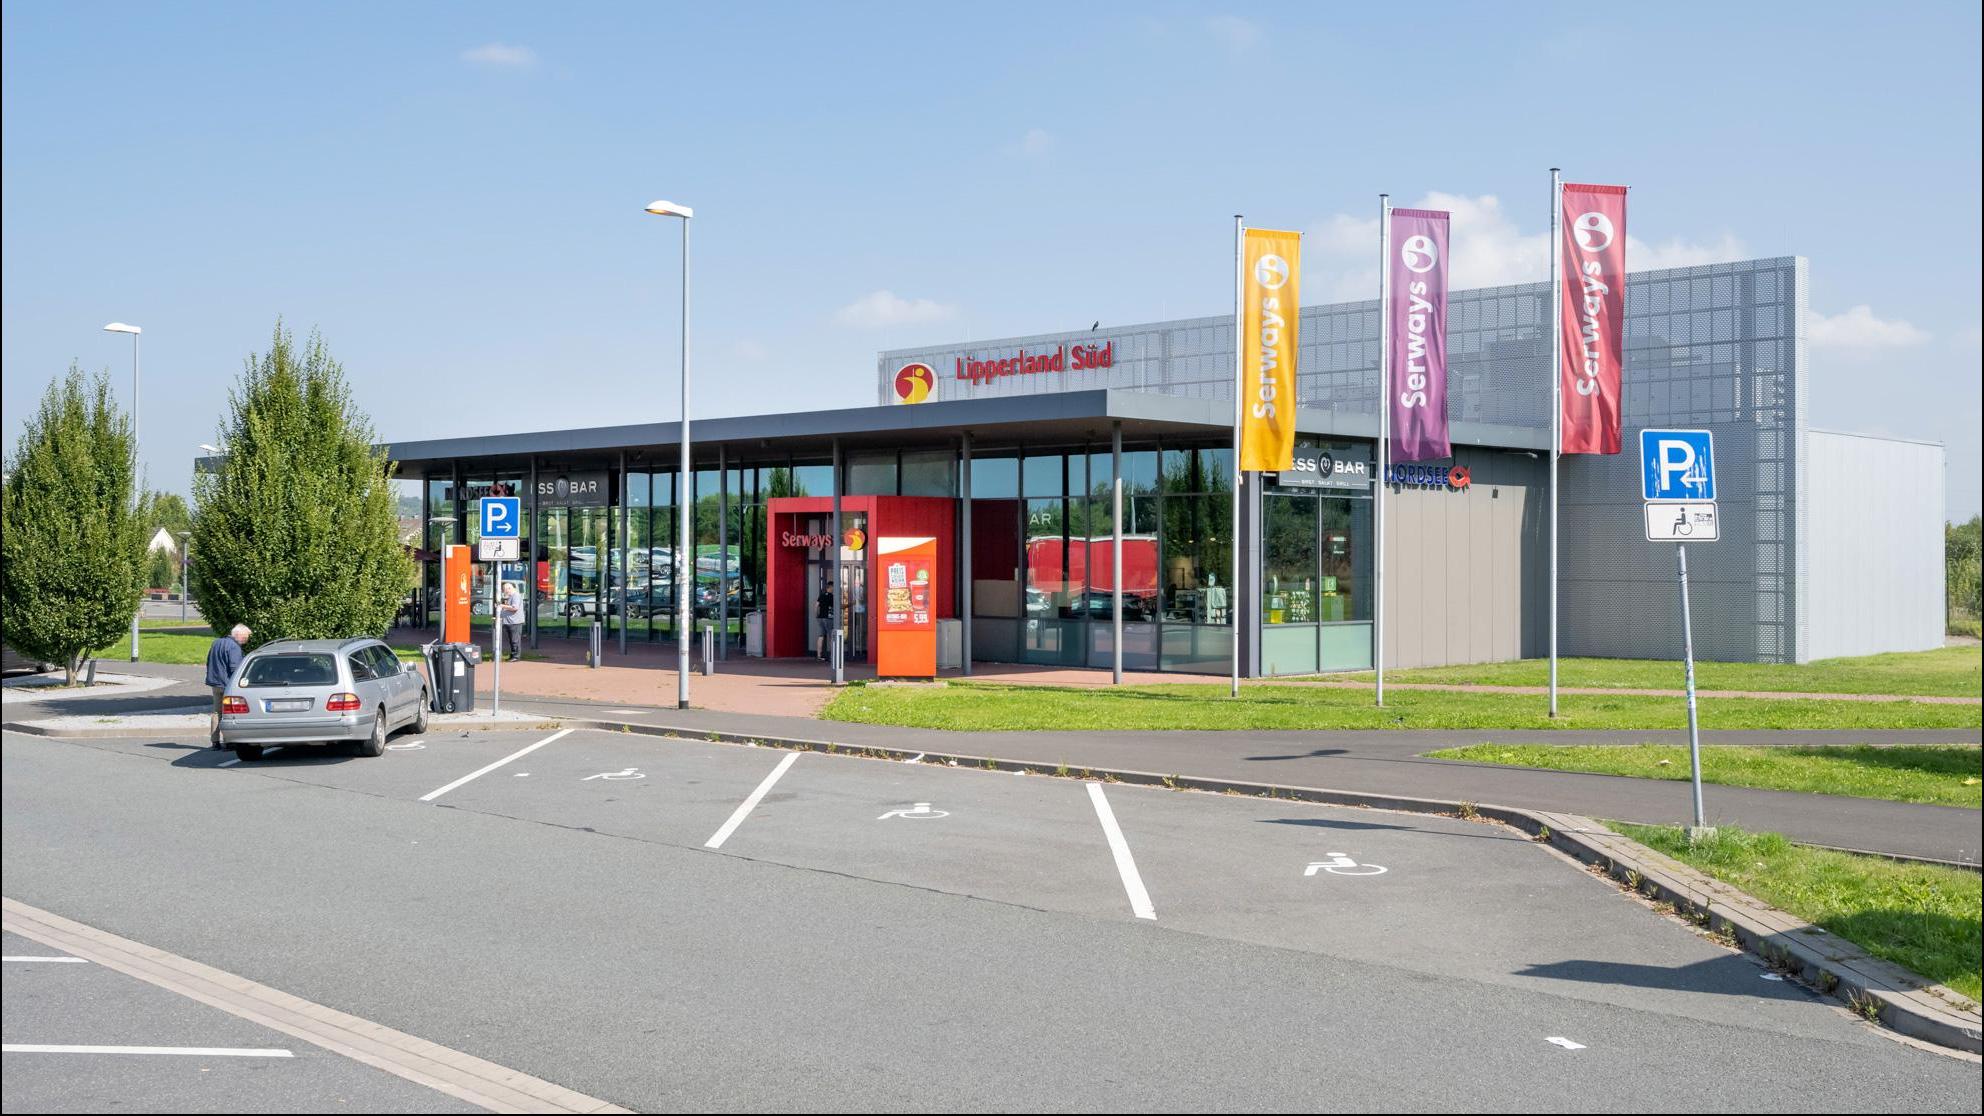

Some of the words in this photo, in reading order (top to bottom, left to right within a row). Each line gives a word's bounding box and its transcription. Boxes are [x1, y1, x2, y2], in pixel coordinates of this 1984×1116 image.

[1401, 281, 1433, 408] Serways
[1576, 260, 1609, 397] Serways
[956, 345, 1064, 385] Lipperland
[1070, 339, 1113, 371] Süd
[1252, 296, 1285, 420] Serways
[1334, 460, 1365, 475] BAR
[1384, 463, 1449, 485] NORDSEE
[1658, 439, 1696, 491] P
[530, 482, 554, 495] SS
[570, 480, 597, 494] BAR
[487, 503, 507, 532] P
[781, 531, 832, 552] Serways
